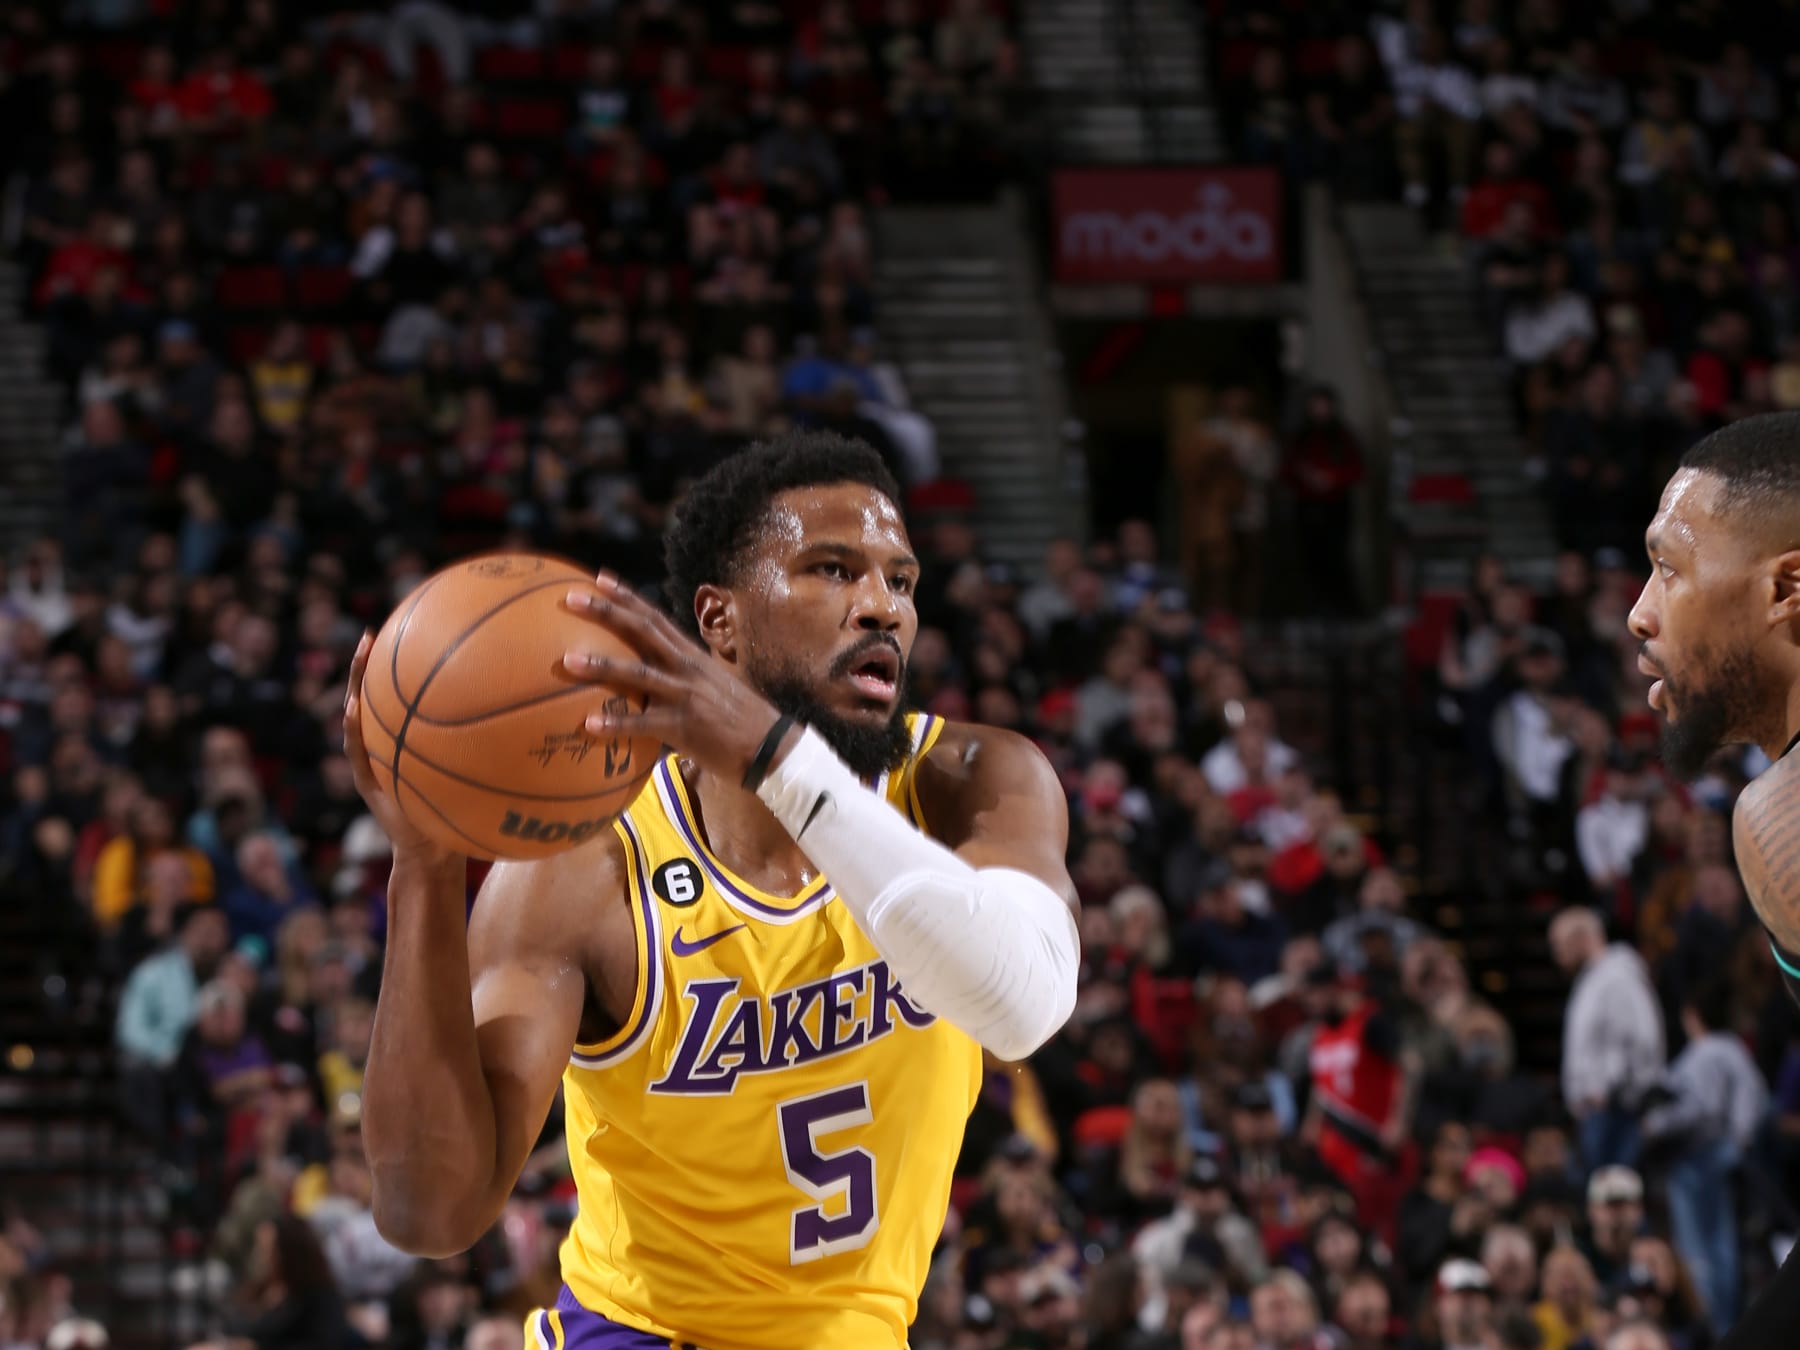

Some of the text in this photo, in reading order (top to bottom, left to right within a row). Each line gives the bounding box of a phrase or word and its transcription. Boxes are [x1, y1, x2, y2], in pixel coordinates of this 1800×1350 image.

[1061, 184, 1273, 261] moda
[664, 865, 695, 902] 6
[647, 958, 938, 1097] LAKER
[776, 1079, 880, 1266] 5
